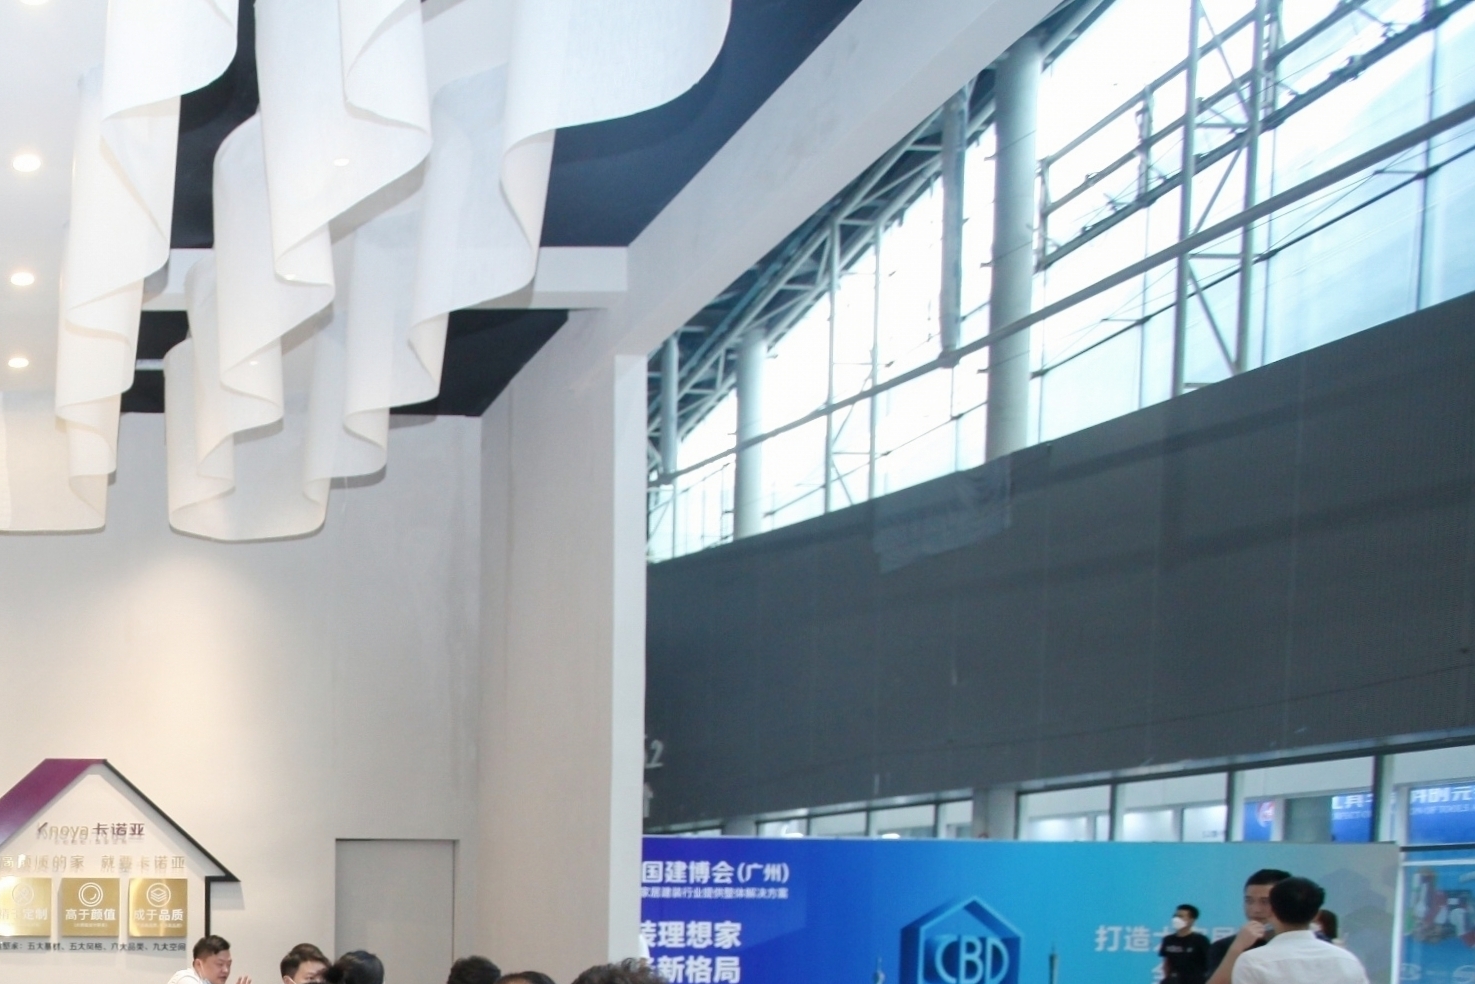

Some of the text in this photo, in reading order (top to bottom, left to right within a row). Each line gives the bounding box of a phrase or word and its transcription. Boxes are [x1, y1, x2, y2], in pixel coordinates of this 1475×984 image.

[37, 821, 145, 839] Knoya 卡诺亚
[641, 860, 790, 884] 国建博会(广州)
[65, 909, 117, 922] 高于颜值
[134, 909, 184, 922] 成于品质
[646, 955, 742, 984] 新格局
